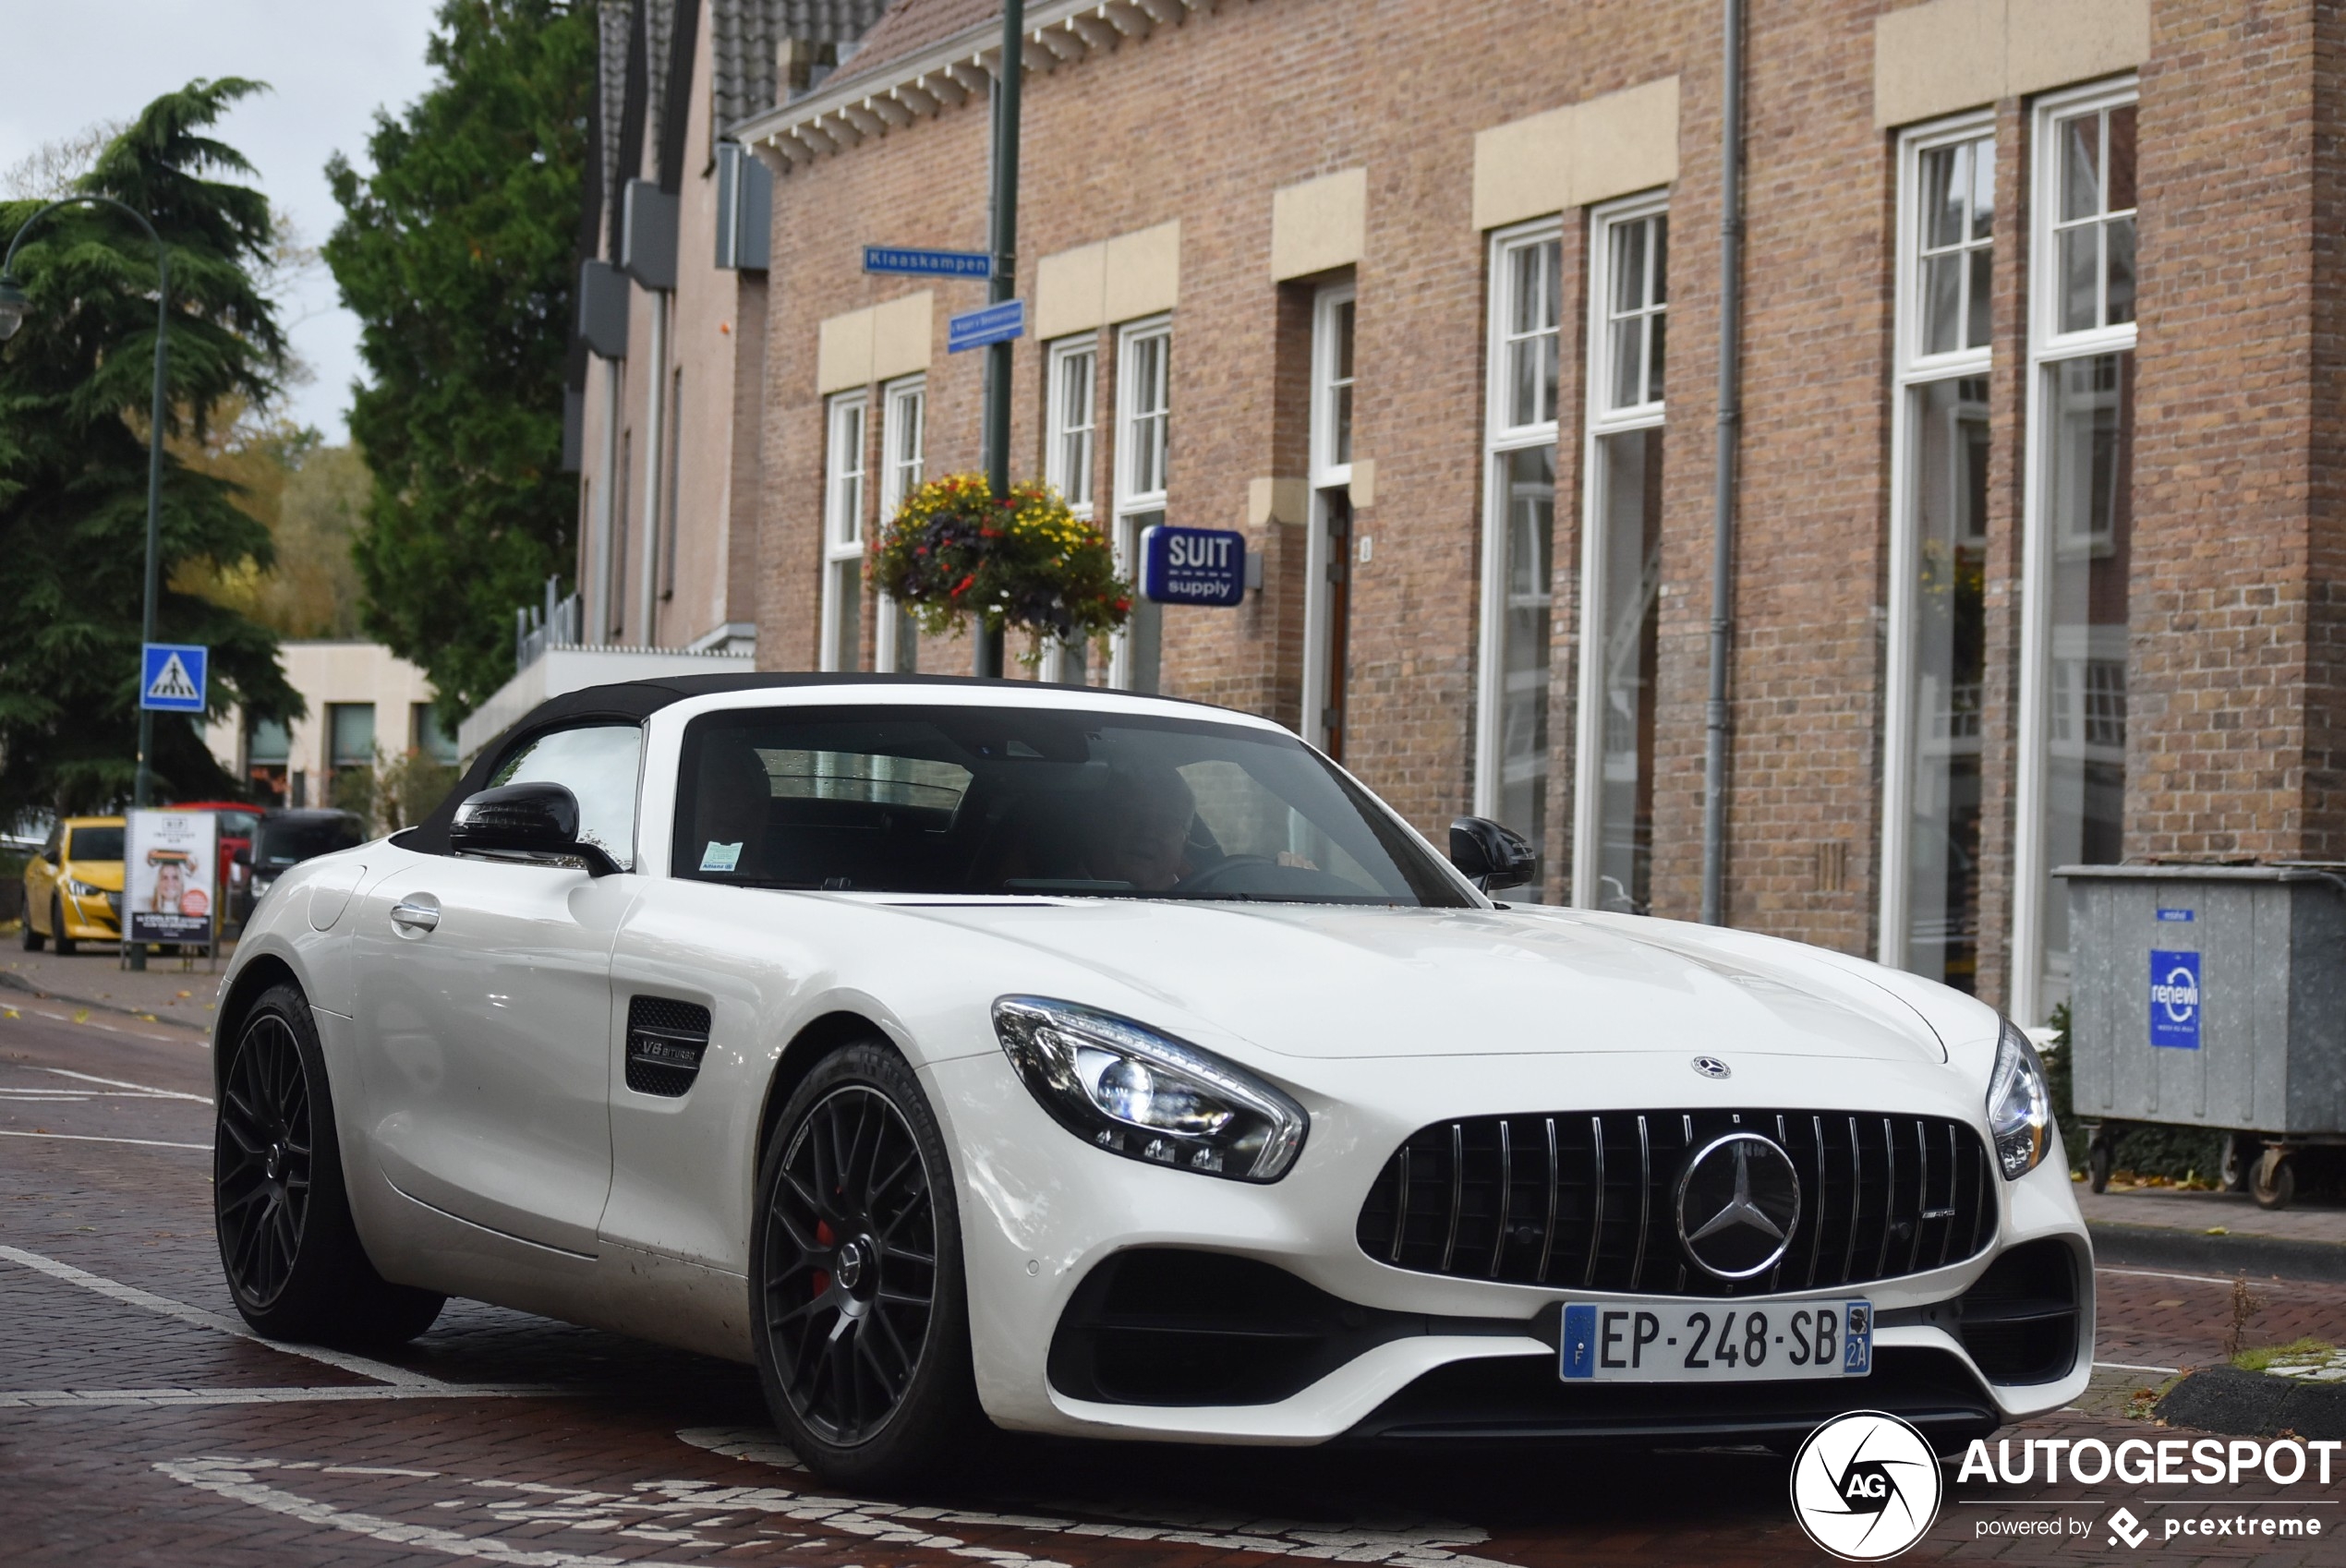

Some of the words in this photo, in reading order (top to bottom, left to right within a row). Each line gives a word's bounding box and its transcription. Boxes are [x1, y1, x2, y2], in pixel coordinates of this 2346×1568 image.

[869, 252, 987, 272] Klaaskampen
[1168, 535, 1233, 568] SUIT
[1167, 580, 1231, 598] supply
[2151, 984, 2199, 1006] renewi
[643, 1041, 662, 1055] V8
[662, 1048, 695, 1061] BITURBO
[898, 1080, 946, 1176] MICHELIN
[1574, 1350, 1584, 1366] F
[1600, 1309, 1838, 1369] EP-248-SB
[1846, 1341, 1867, 1368] 2A
